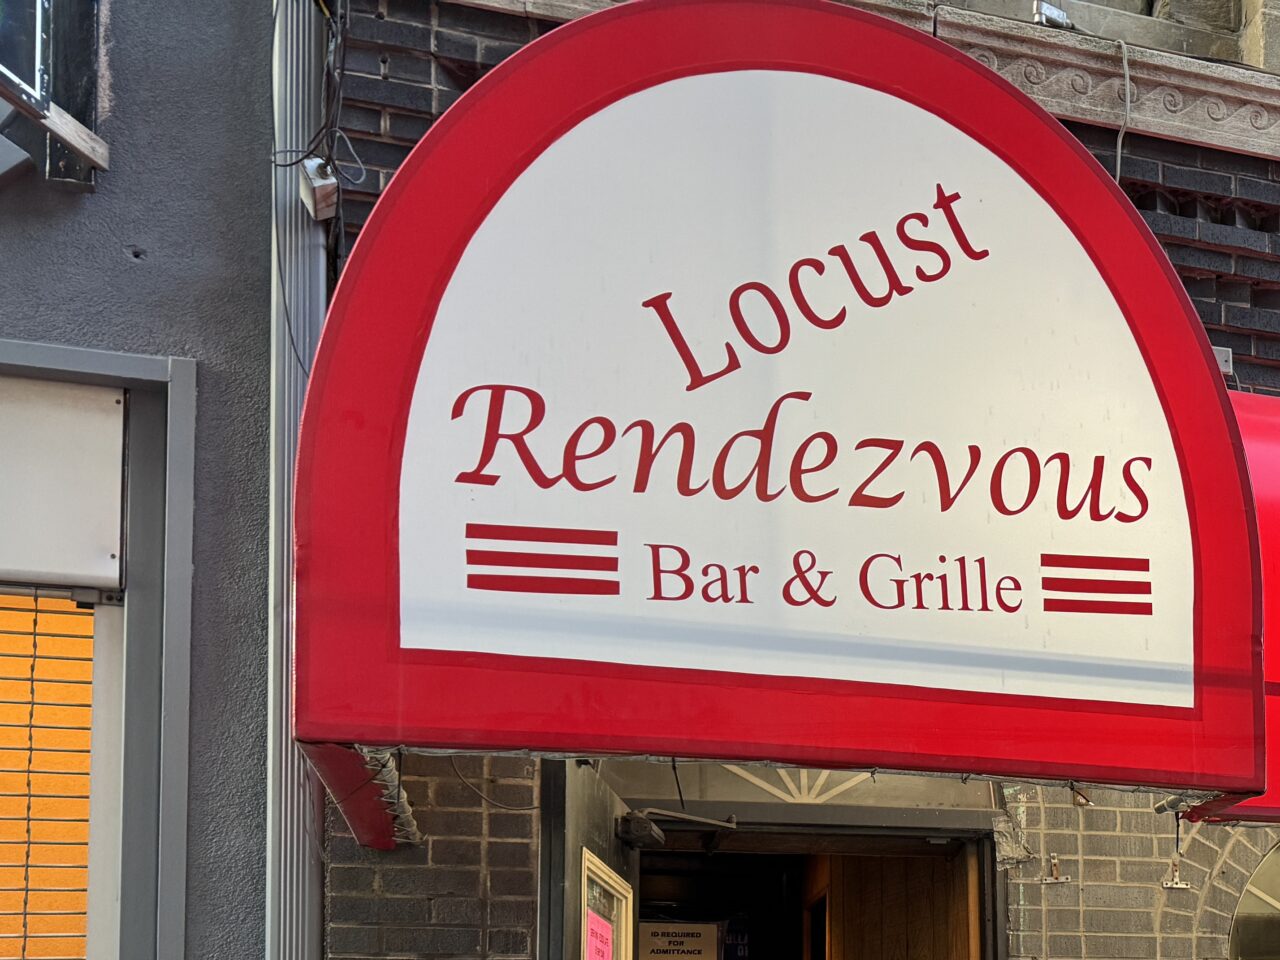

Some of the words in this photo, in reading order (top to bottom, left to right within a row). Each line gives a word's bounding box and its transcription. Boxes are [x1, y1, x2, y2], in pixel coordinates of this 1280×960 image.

[642, 182, 990, 392] Locust
[450, 383, 1153, 524] Rendezvous
[645, 542, 760, 605] Bar
[782, 549, 836, 608] &
[858, 553, 1024, 615] Grille
[649, 948, 703, 956] ADMITTANCE
